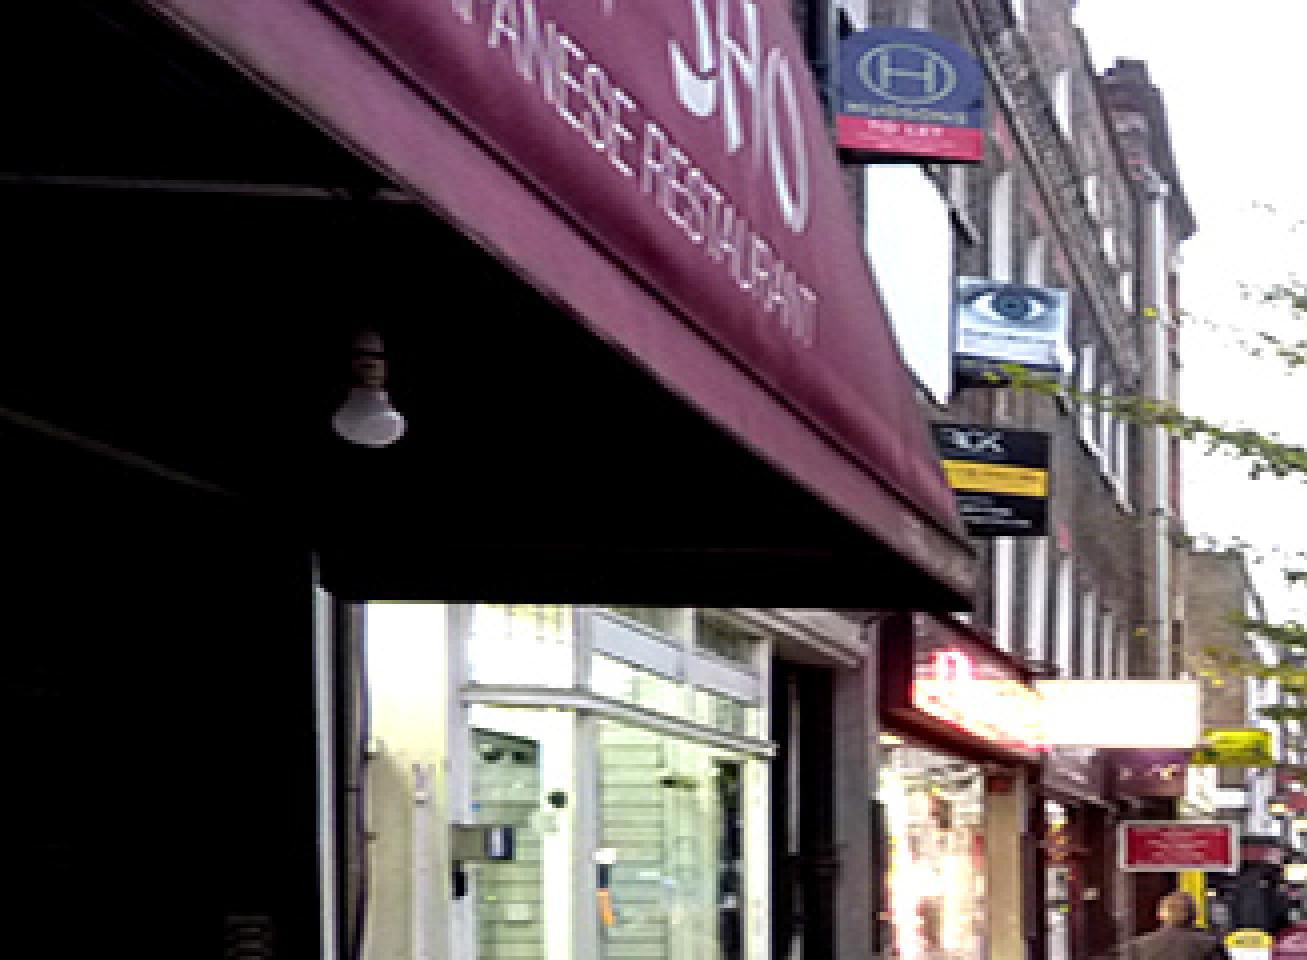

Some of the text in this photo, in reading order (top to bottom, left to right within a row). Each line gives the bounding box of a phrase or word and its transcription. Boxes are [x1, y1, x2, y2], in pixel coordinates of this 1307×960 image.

[866, 118, 944, 138] TO LET
[642, 122, 818, 348] RESTAURANT
